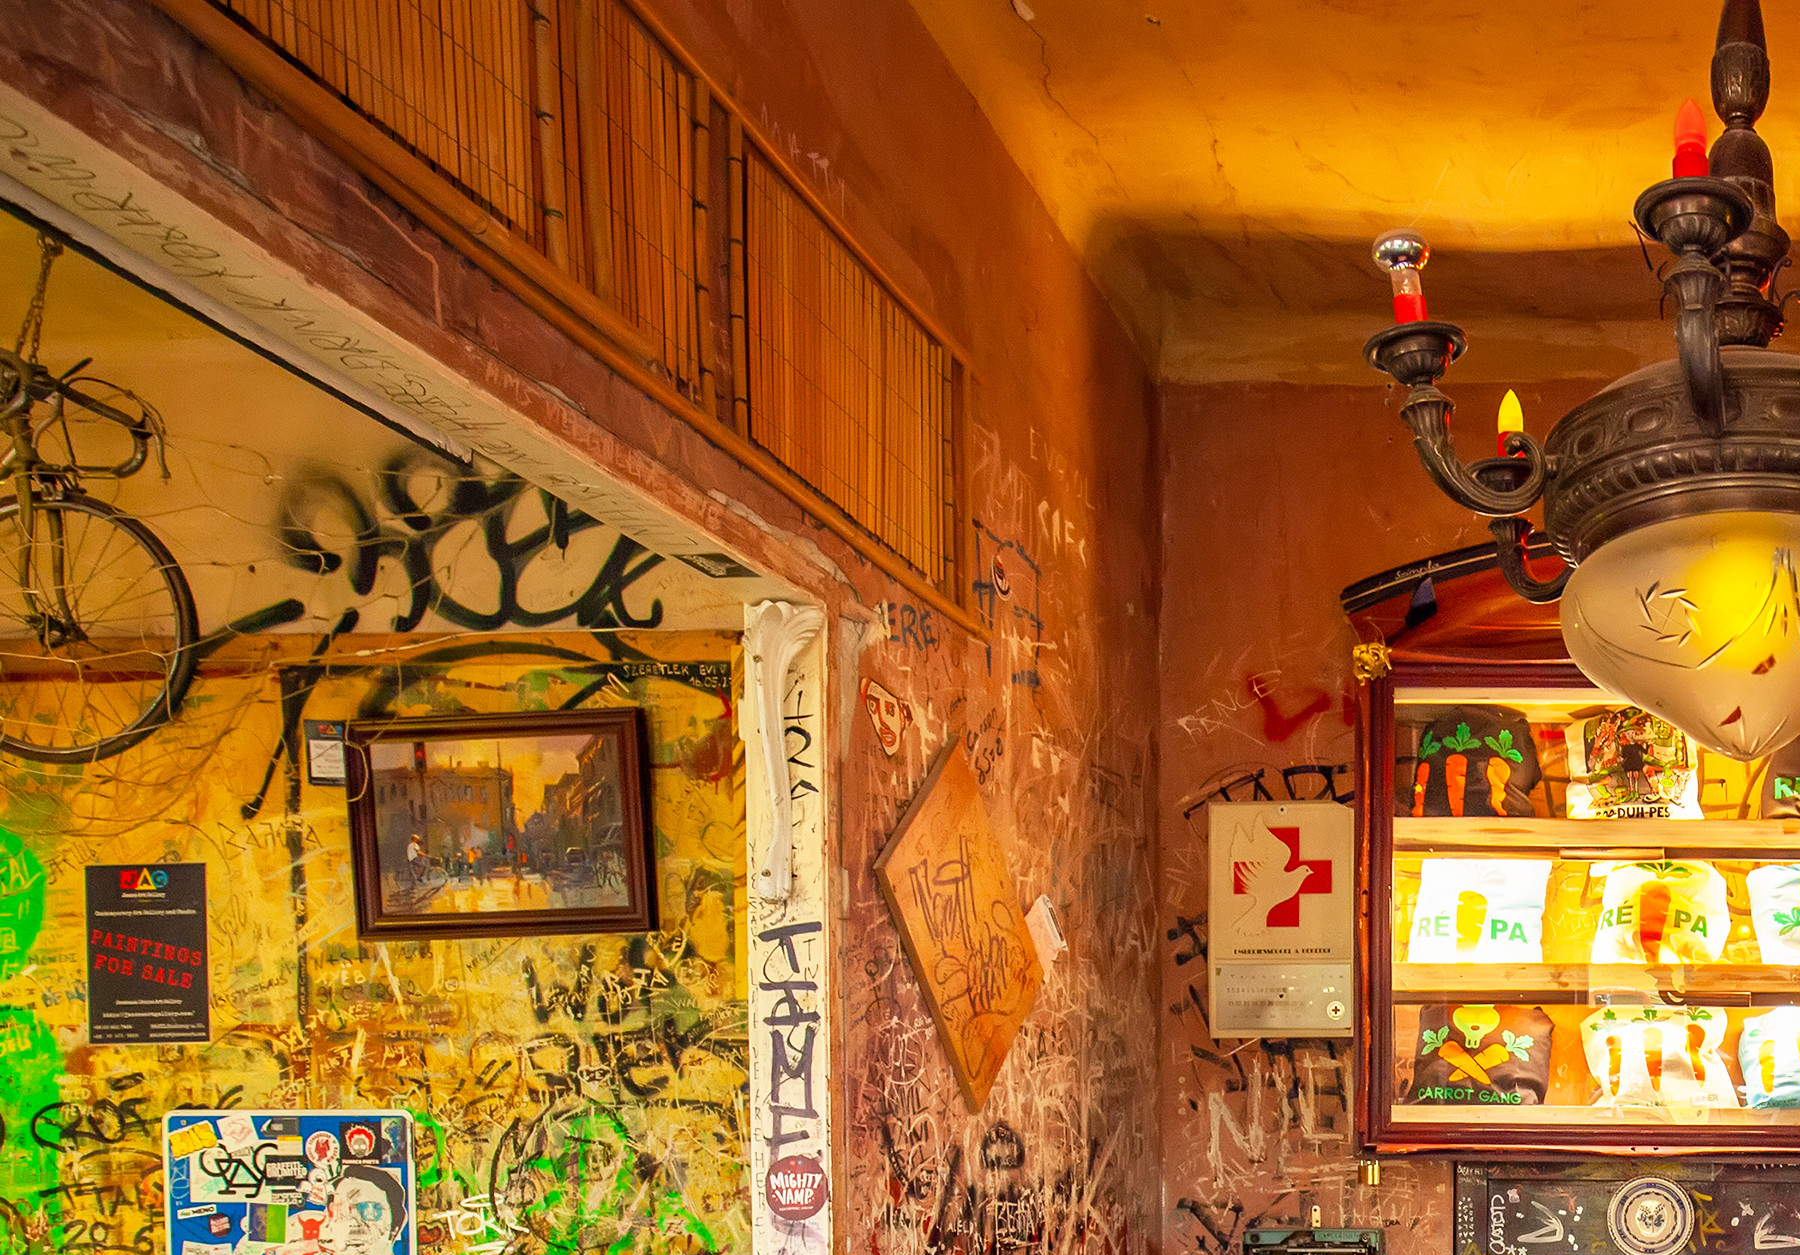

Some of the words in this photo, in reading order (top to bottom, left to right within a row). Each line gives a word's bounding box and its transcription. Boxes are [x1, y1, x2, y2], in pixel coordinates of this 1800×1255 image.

[120, 867, 169, 890] JAG
[1417, 910, 1450, 938] RÉ
[1490, 918, 1528, 945] PA
[1600, 900, 1633, 930] RÉ
[1673, 909, 1708, 939] PA
[91, 928, 203, 967] PAINTINGS
[94, 953, 134, 977] FOR
[141, 964, 194, 989] SALE
[1417, 1087, 1474, 1103] CARROT
[1479, 1089, 1522, 1105] GANG
[773, 1189, 815, 1206] VAMP
